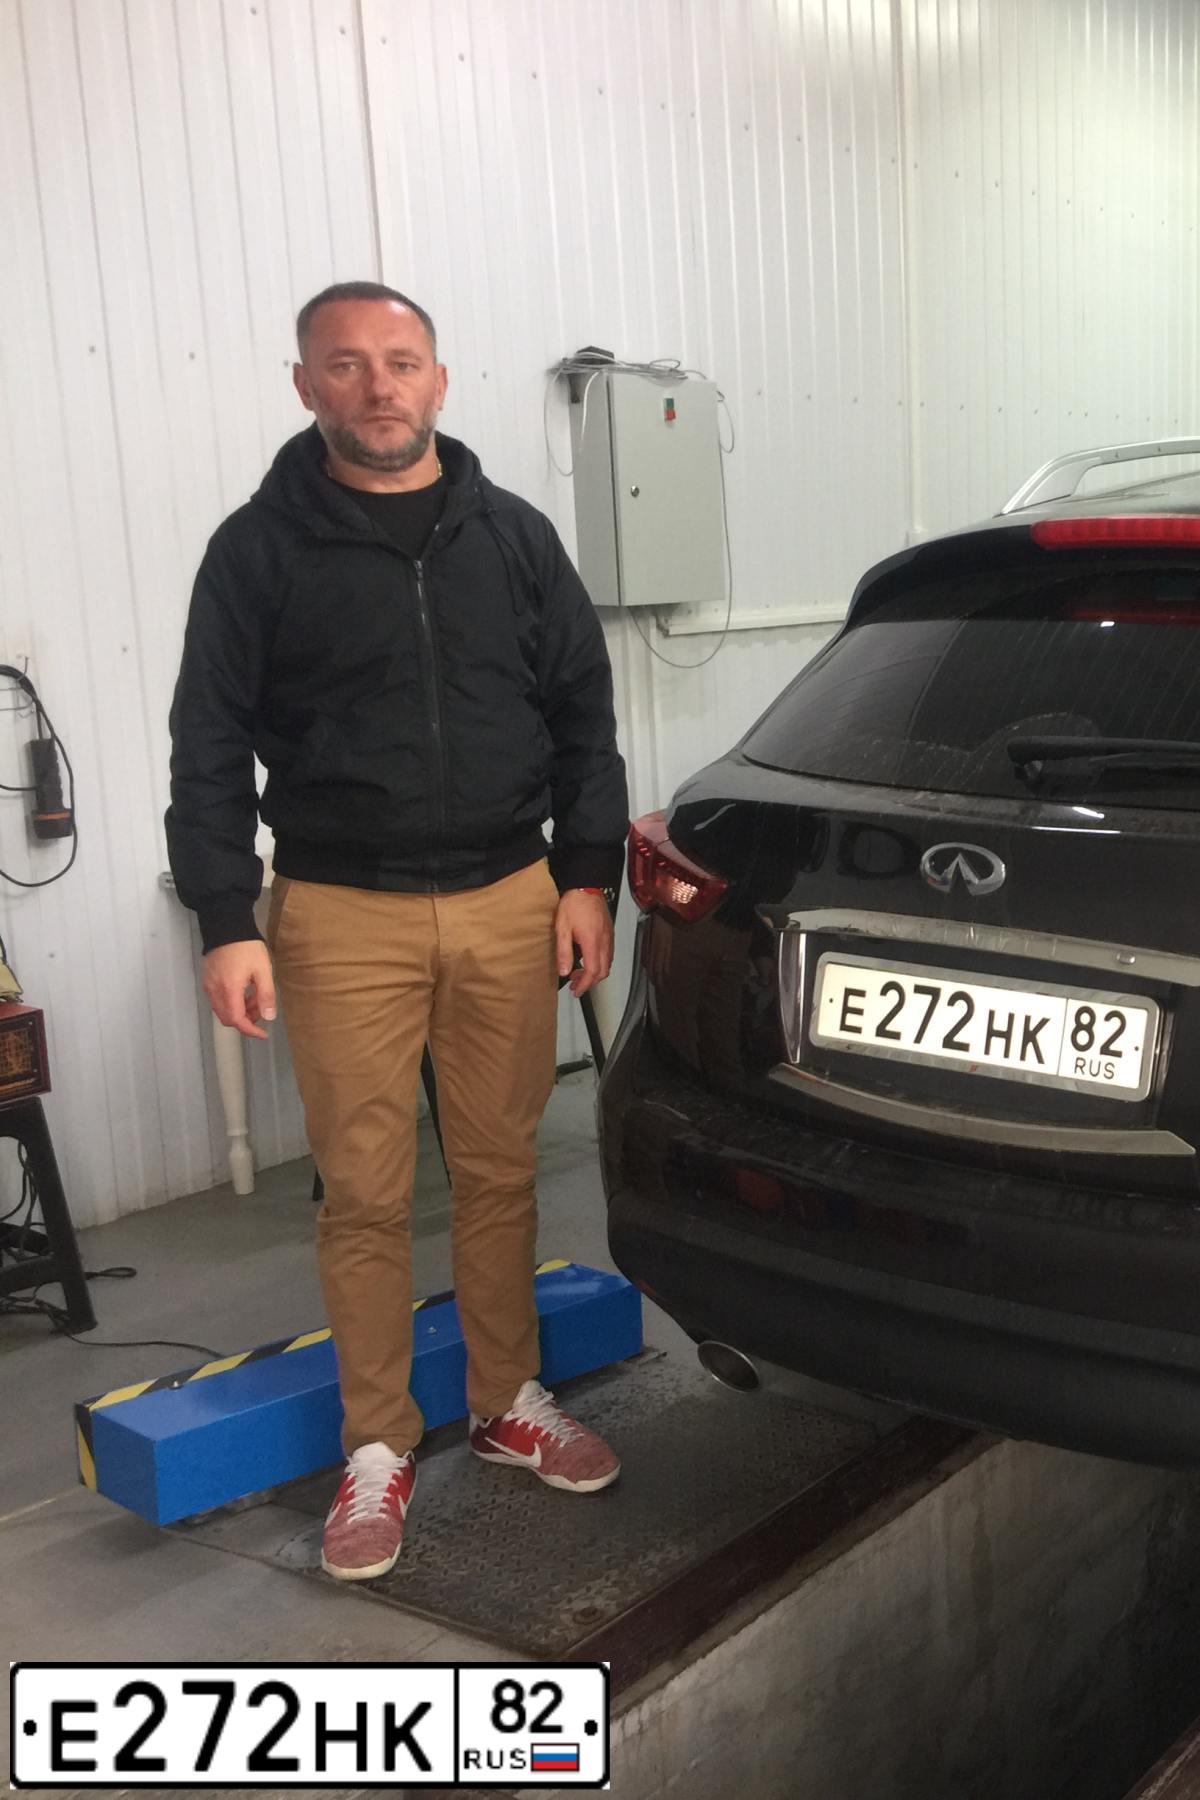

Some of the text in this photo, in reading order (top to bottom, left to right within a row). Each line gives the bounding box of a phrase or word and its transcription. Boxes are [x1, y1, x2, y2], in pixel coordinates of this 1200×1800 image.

[840, 980, 1127, 1065] E272HK 82
[1074, 1057, 1116, 1080] RUS
